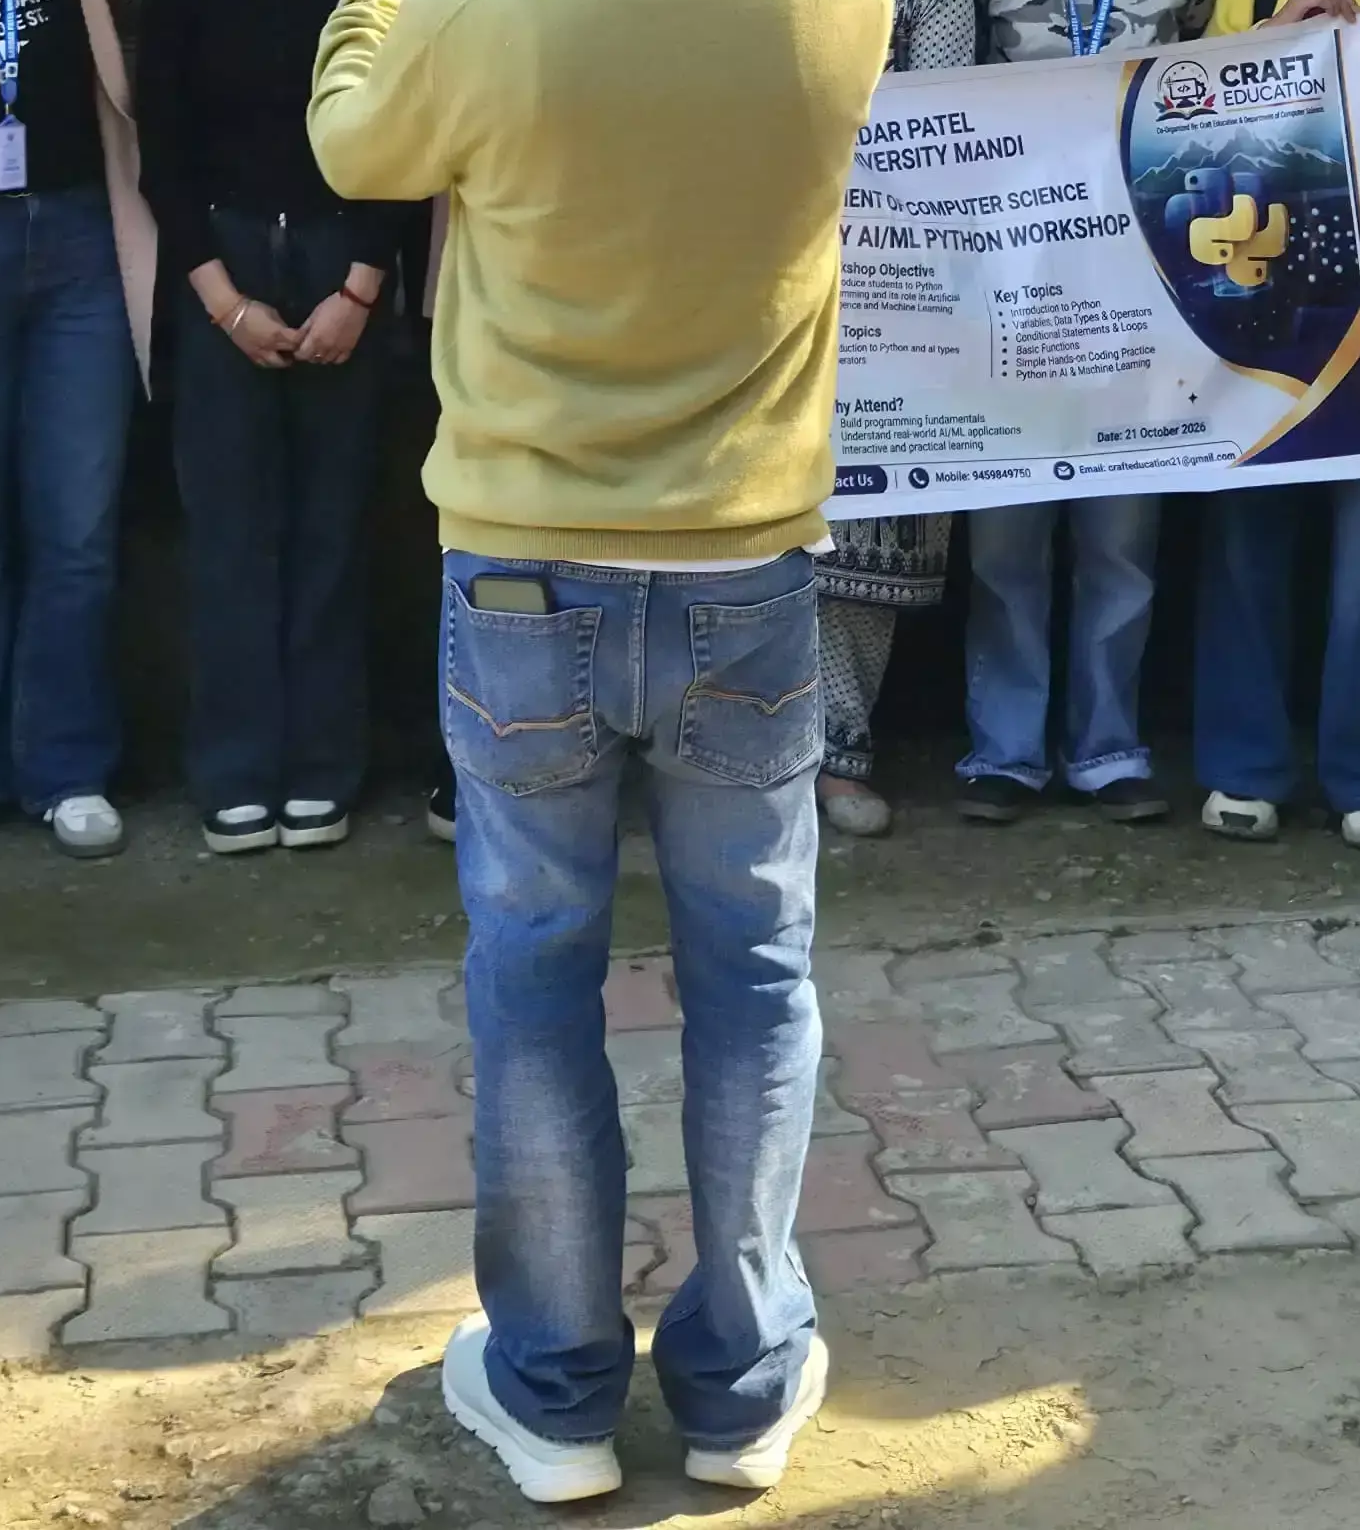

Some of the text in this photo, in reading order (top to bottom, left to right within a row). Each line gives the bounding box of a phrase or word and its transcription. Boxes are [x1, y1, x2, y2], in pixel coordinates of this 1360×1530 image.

[1220, 53, 1314, 88] CRAFT
[1223, 77, 1326, 107] EDUCATION
[856, 112, 975, 146] DAR PATEL
[954, 134, 1024, 164] MANDI
[906, 195, 1004, 217] COMPUTER
[1007, 182, 1089, 210] SCIENCE
[857, 225, 921, 250] AI/ML
[924, 228, 1003, 253] PYTHON
[1006, 213, 1130, 248] WORKSHOP
[840, 262, 935, 279] kshop Objective
[868, 279, 903, 289] students
[905, 281, 913, 290] to
[915, 281, 943, 292] Python
[994, 282, 1063, 305] Key Topics
[872, 291, 887, 300] and
[889, 291, 899, 300] its
[901, 292, 916, 301] role
[927, 293, 960, 303] Artificial
[864, 301, 879, 310] and
[881, 302, 915, 312] Machine
[917, 304, 953, 315] Learning
[1011, 300, 1101, 317] Introduction to Python
[1054, 316, 1073, 327] Data
[1073, 313, 1100, 325] Types
[1101, 311, 1108, 320] &
[1109, 307, 1152, 320] Operators
[841, 324, 882, 340] Topics
[1015, 321, 1148, 343] Conditional Statements & Loops
[869, 343, 878, 352] to
[880, 343, 909, 354] Python
[910, 344, 926, 353] and
[937, 345, 960, 356] types
[1016, 340, 1080, 355] Basic Functions
[1015, 344, 1156, 369] Simple Hands-on Coding Practice
[1016, 369, 1047, 381] Python
[1049, 368, 1057, 378] in
[1070, 367, 1077, 377] &
[1077, 363, 1114, 376] Machine
[1115, 358, 1151, 372] Learning
[835, 398, 904, 416] hy Attend?
[840, 413, 985, 430] Build programming fundamentals
[841, 424, 1022, 441] Understand real-world AI/ML applications
[1097, 431, 1123, 443] Date:
[1125, 428, 1137, 440] 21
[1140, 426, 1180, 439] October
[842, 438, 984, 455] Interactive and practical learning
[1079, 452, 1236, 475] Email: crafteducation21@gmail.com
[857, 473, 874, 487] Us
[935, 467, 1031, 482] Mobile: 9459849750
